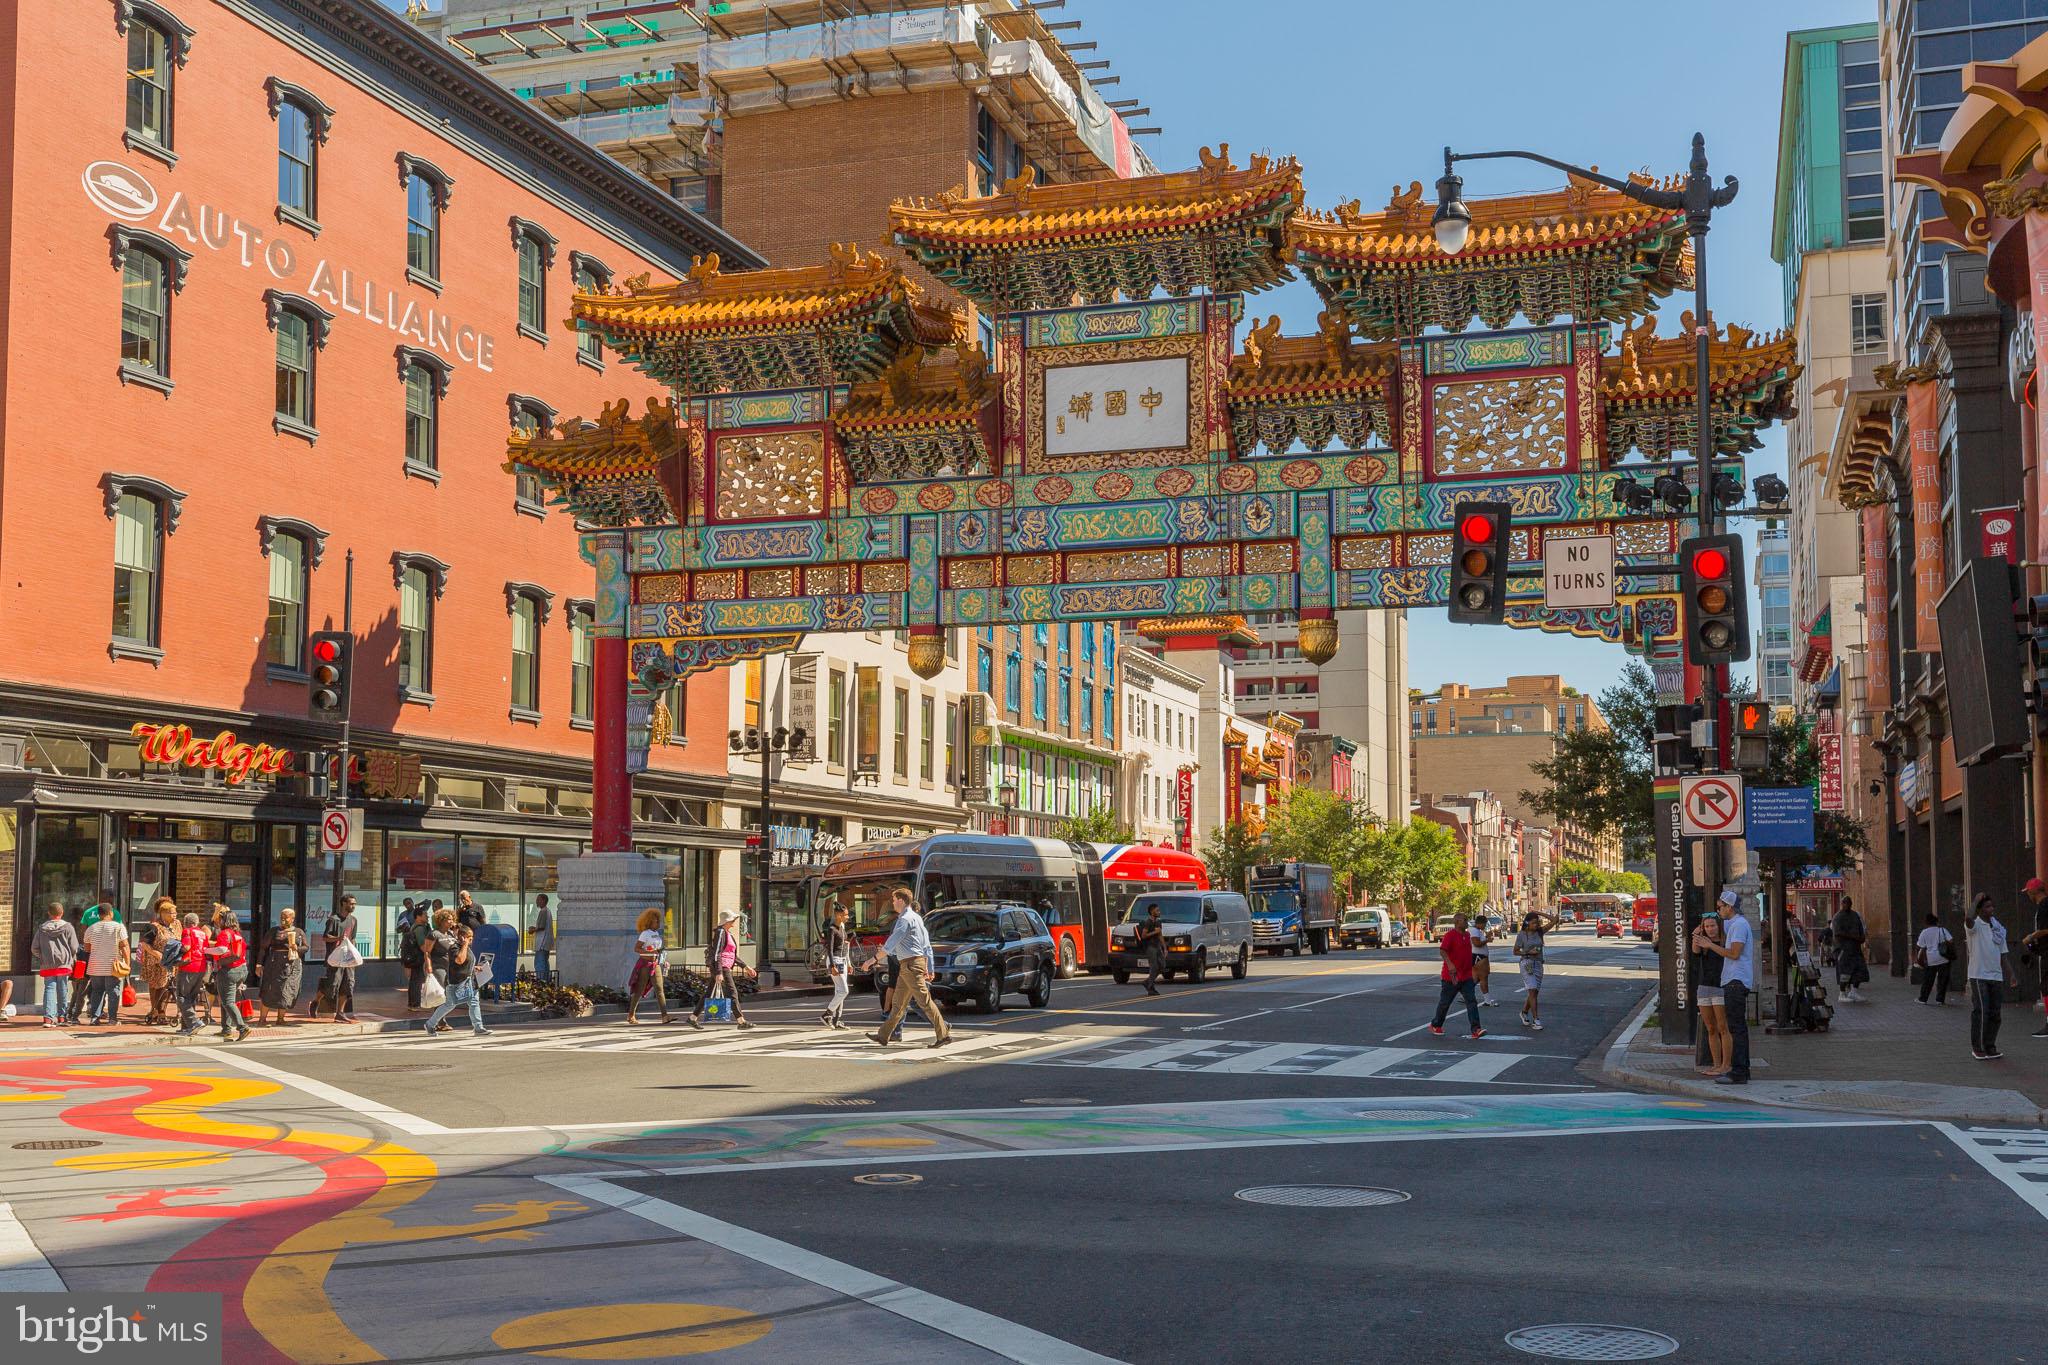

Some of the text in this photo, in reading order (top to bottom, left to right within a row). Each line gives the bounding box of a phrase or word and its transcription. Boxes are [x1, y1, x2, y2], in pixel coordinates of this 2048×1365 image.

[158, 191, 495, 372] AUTO ALLIANCE
[1988, 519, 2010, 534] WSC
[1568, 546, 1589, 562] NO
[1553, 572, 1605, 590] TURNS
[1670, 802, 1681, 853] Gallery
[814, 831, 847, 851] Elite
[1675, 957, 1686, 1009] Station
